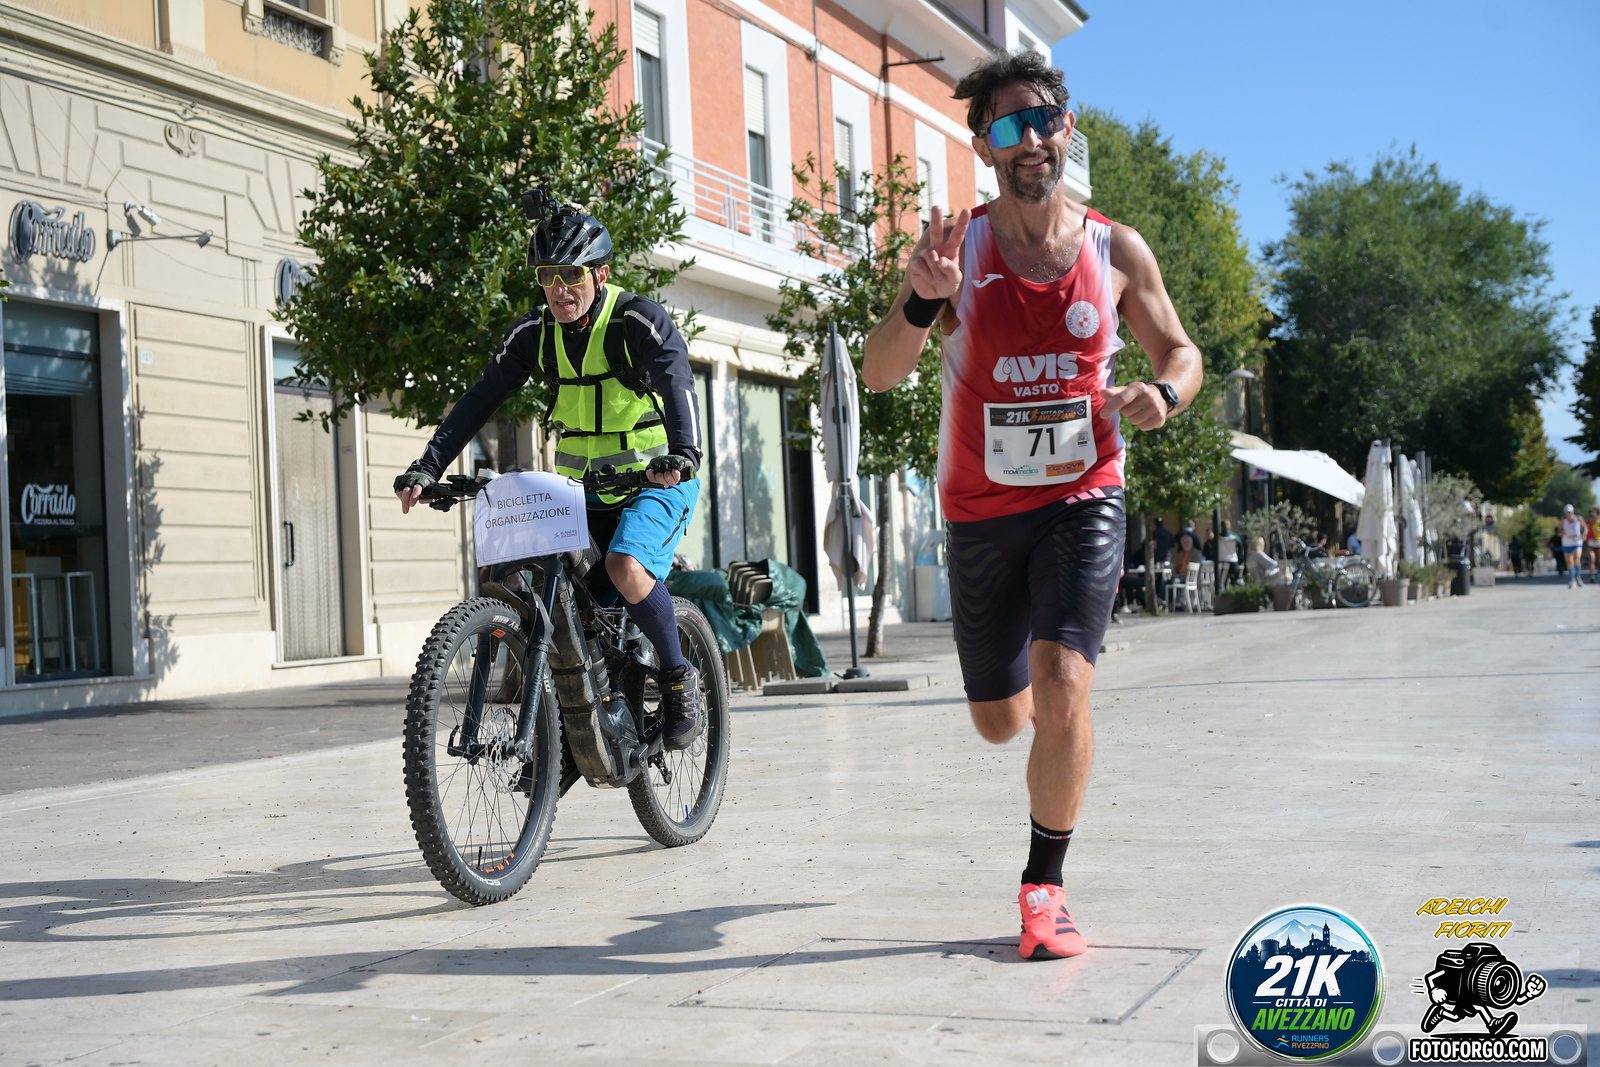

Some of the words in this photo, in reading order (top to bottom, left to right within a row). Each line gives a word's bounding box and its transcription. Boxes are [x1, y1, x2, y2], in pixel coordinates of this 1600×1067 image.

[8, 200, 96, 264] Corrado
[993, 353, 1079, 383] AVIS
[1013, 383, 1060, 397] VASTO
[1006, 411, 1031, 424] 21K
[1027, 427, 1056, 457] 71
[21, 483, 76, 524] Corrado
[497, 492, 553, 510] BICICLETTA
[485, 506, 571, 529] ORGANIZZAZIONE
